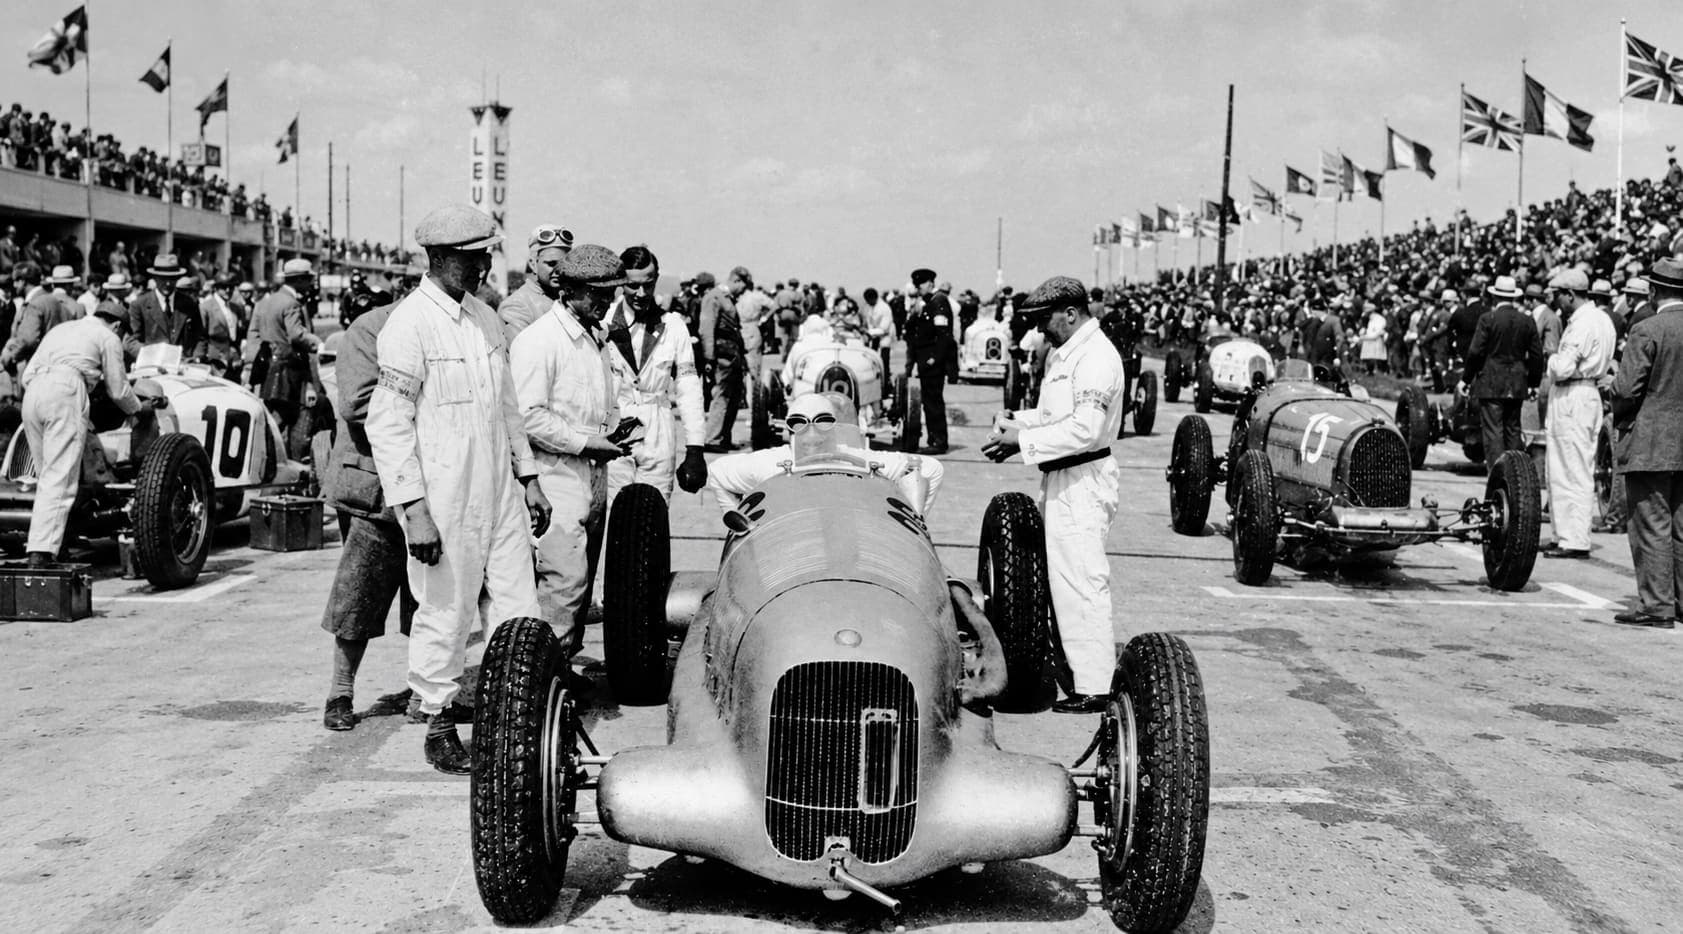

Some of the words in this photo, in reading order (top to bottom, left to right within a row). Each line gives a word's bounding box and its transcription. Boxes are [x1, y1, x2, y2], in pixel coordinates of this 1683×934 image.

[472, 136, 483, 204] LEU
[987, 339, 1001, 360] 8
[201, 405, 251, 479] 10
[1300, 412, 1345, 464] 15
